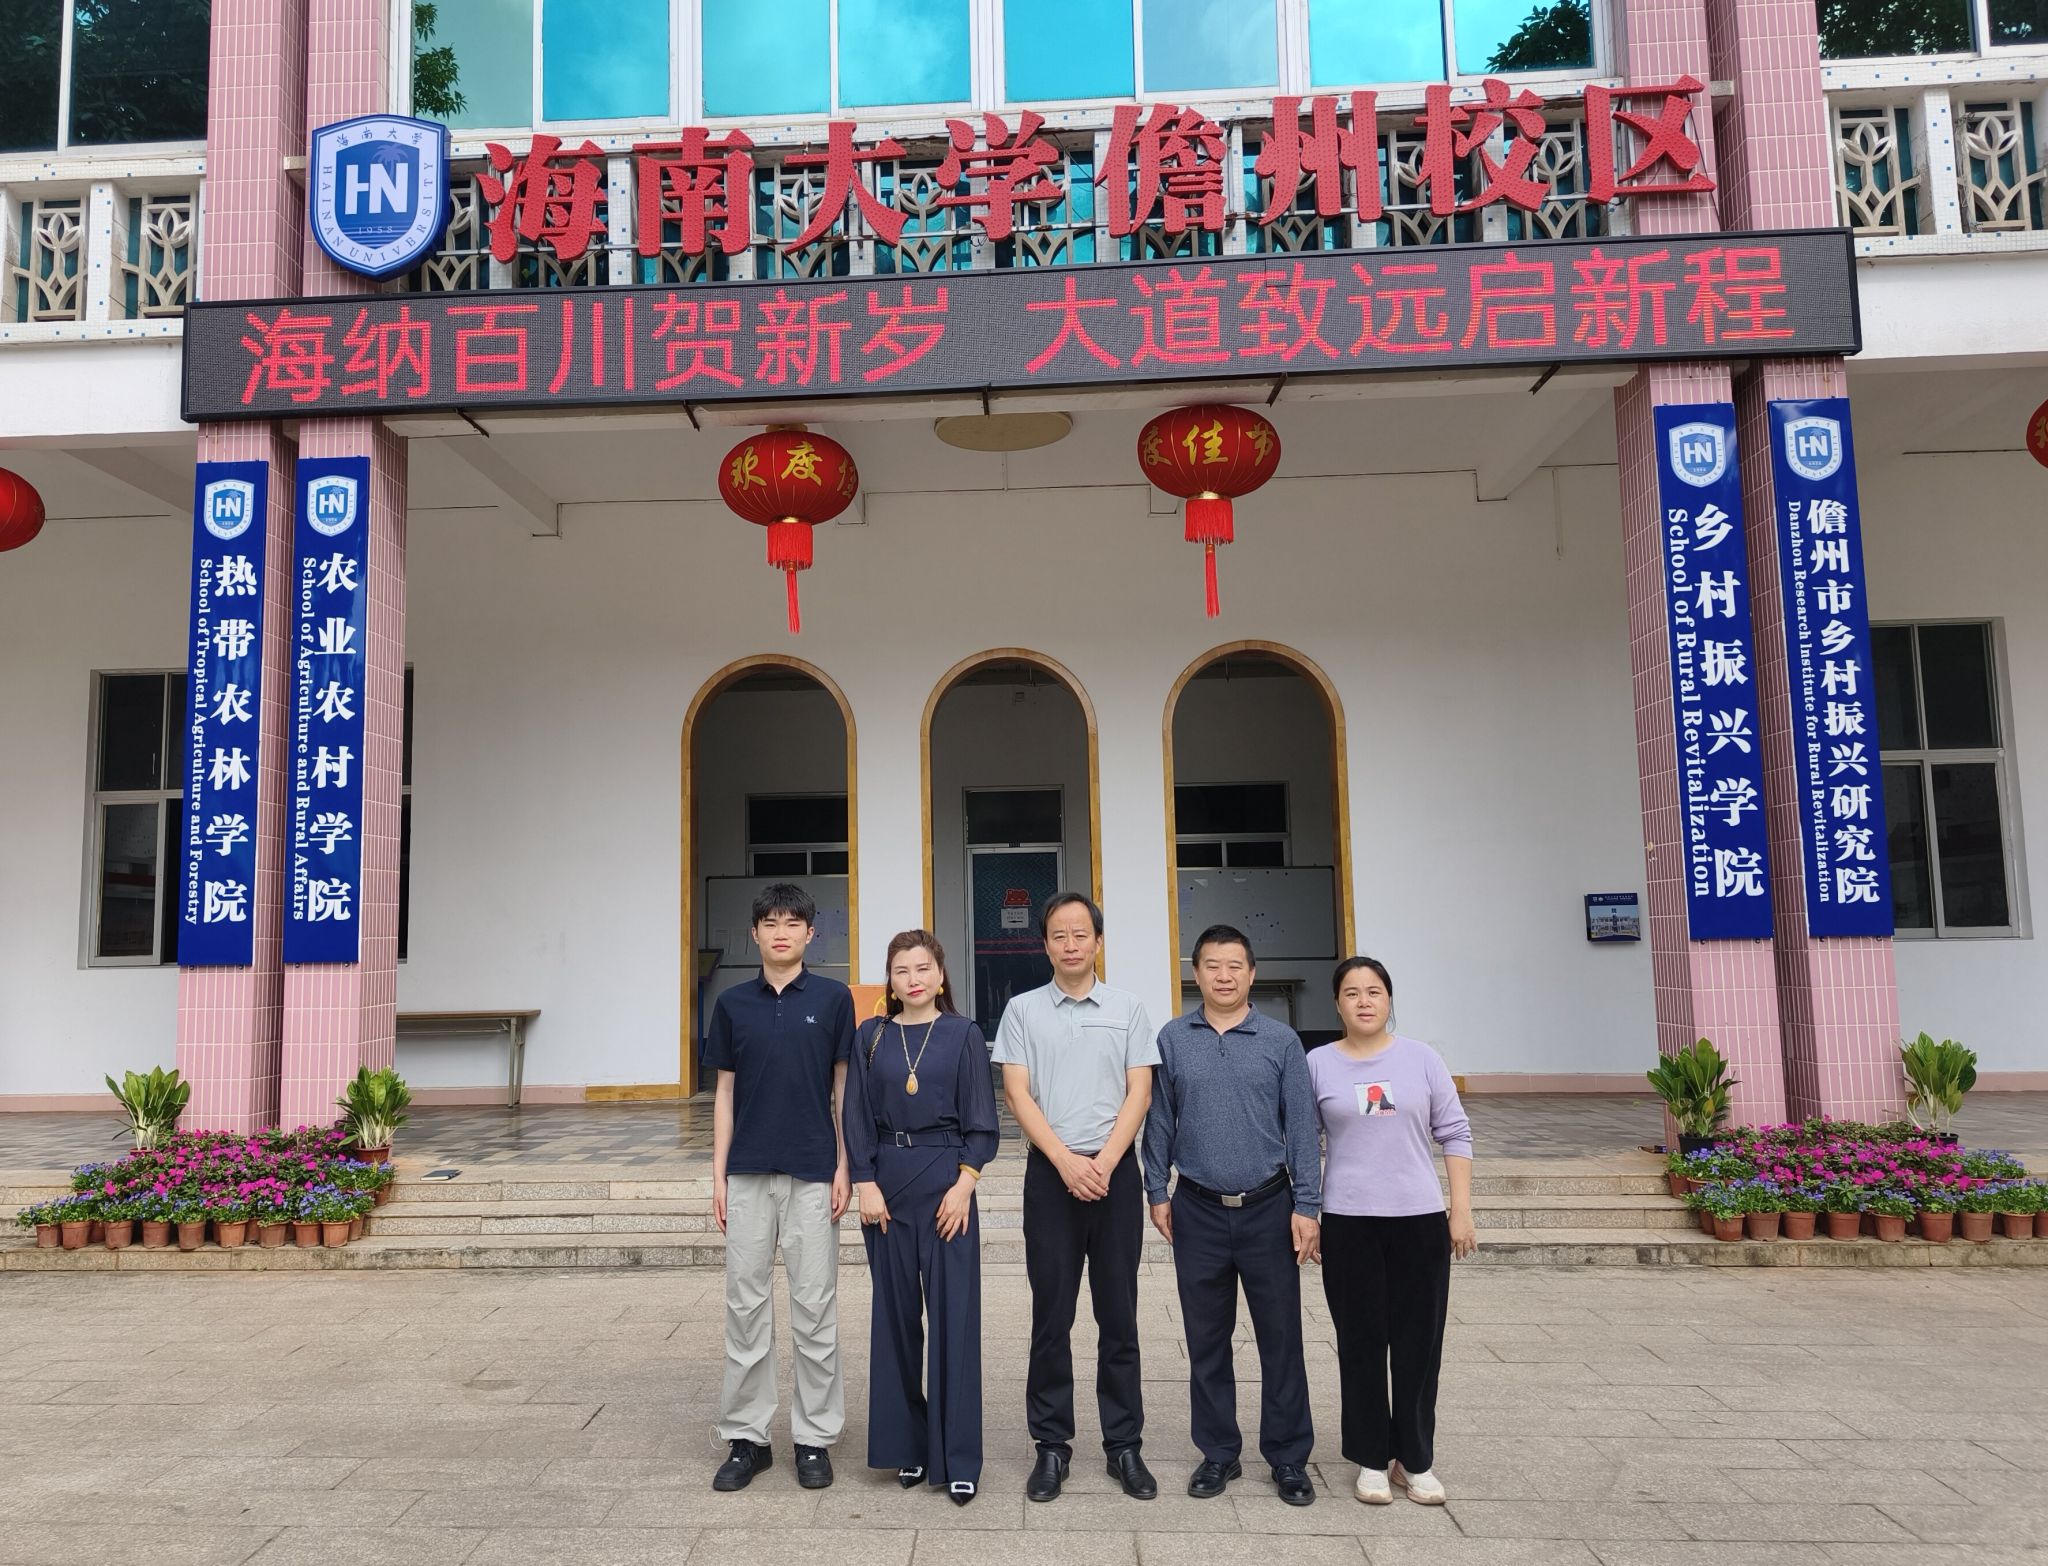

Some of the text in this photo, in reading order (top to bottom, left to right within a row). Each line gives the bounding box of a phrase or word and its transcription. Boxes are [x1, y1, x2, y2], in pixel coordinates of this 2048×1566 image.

[322, 162, 433, 262] HAINAN UNIVERSITY
[345, 163, 409, 214] HN
[477, 74, 1717, 263] 海南大学儋州校区
[241, 247, 1796, 404] 海纳百川贺新岁 大道致远启新程
[1683, 442, 1713, 463] HN
[1799, 435, 1828, 457] HN
[216, 497, 241, 517] HN
[319, 493, 345, 514] HN
[185, 559, 213, 925] School of Tropical Agriculture and Forestry
[203, 555, 257, 922] 热带农林学院
[294, 558, 316, 920] School of Agriculture and Rural Affairs
[307, 553, 358, 921] 农业农村学院
[1668, 508, 1713, 898] School of Rural Revitalization
[1693, 504, 1764, 898] 乡村振兴学院
[1788, 501, 1831, 903] Danzhou Research Institute for Rural Revitalization
[1807, 499, 1880, 904] 儋州市乡村振兴研究院
